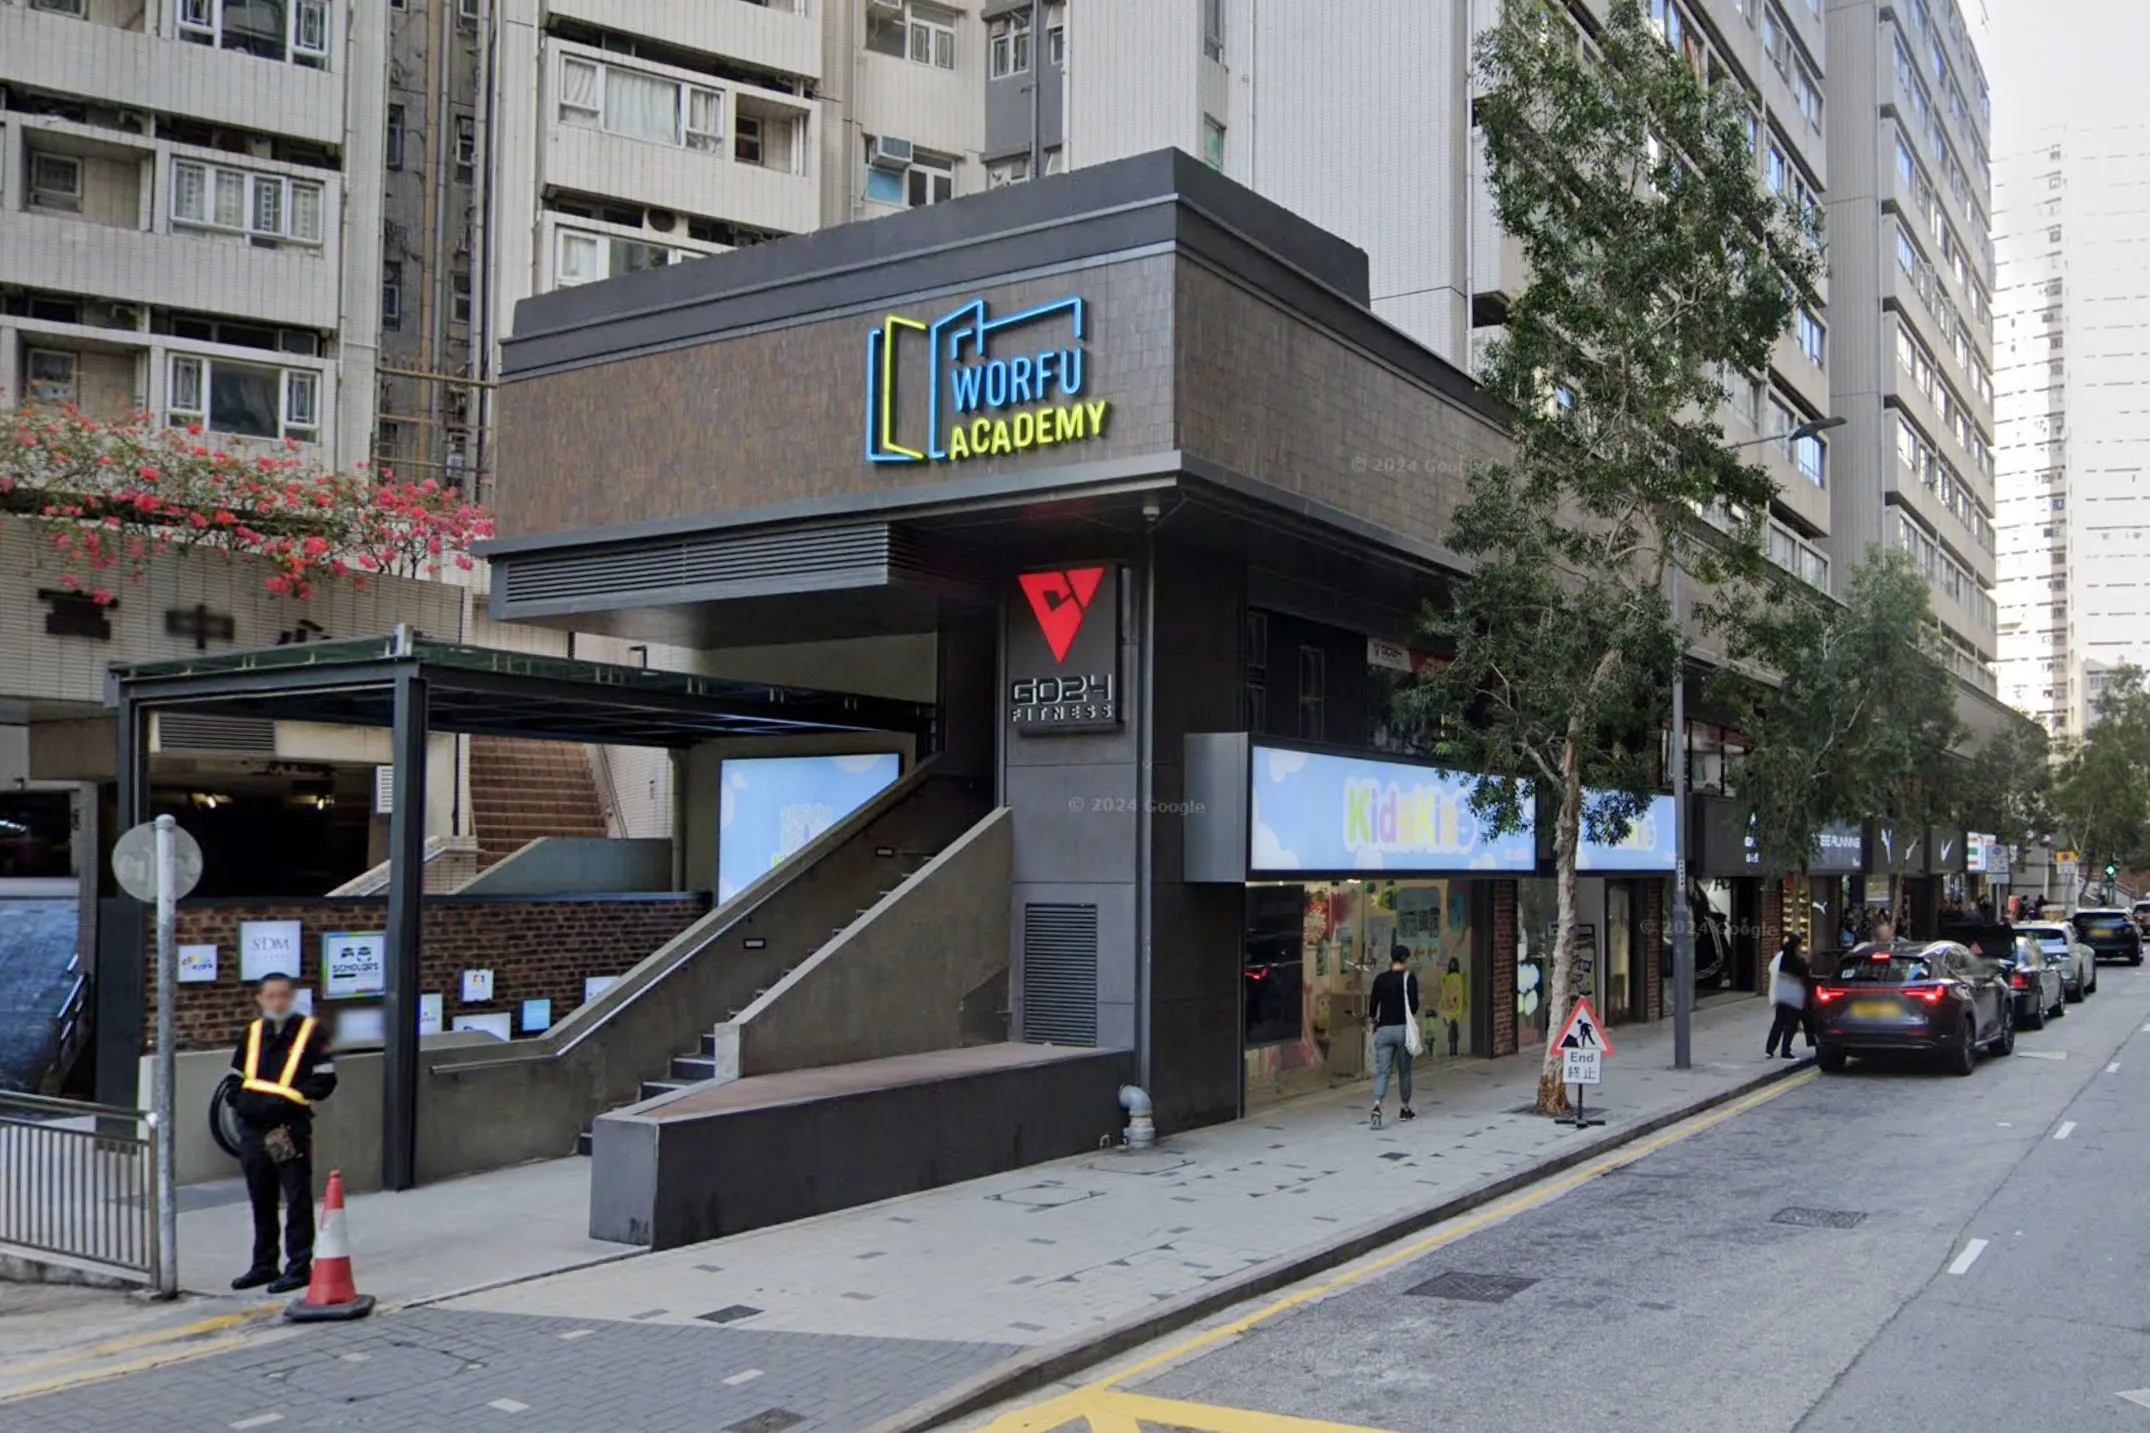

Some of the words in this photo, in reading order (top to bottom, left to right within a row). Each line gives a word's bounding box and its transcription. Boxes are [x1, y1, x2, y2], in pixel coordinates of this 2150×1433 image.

[949, 346, 1083, 413] WORFU
[949, 400, 1107, 461] ACADEMY
[1011, 673, 1112, 705] GO24
[1011, 704, 1113, 722] FITNESS
[1571, 1052, 1594, 1063] End
[1568, 1065, 1597, 1080] 終止
